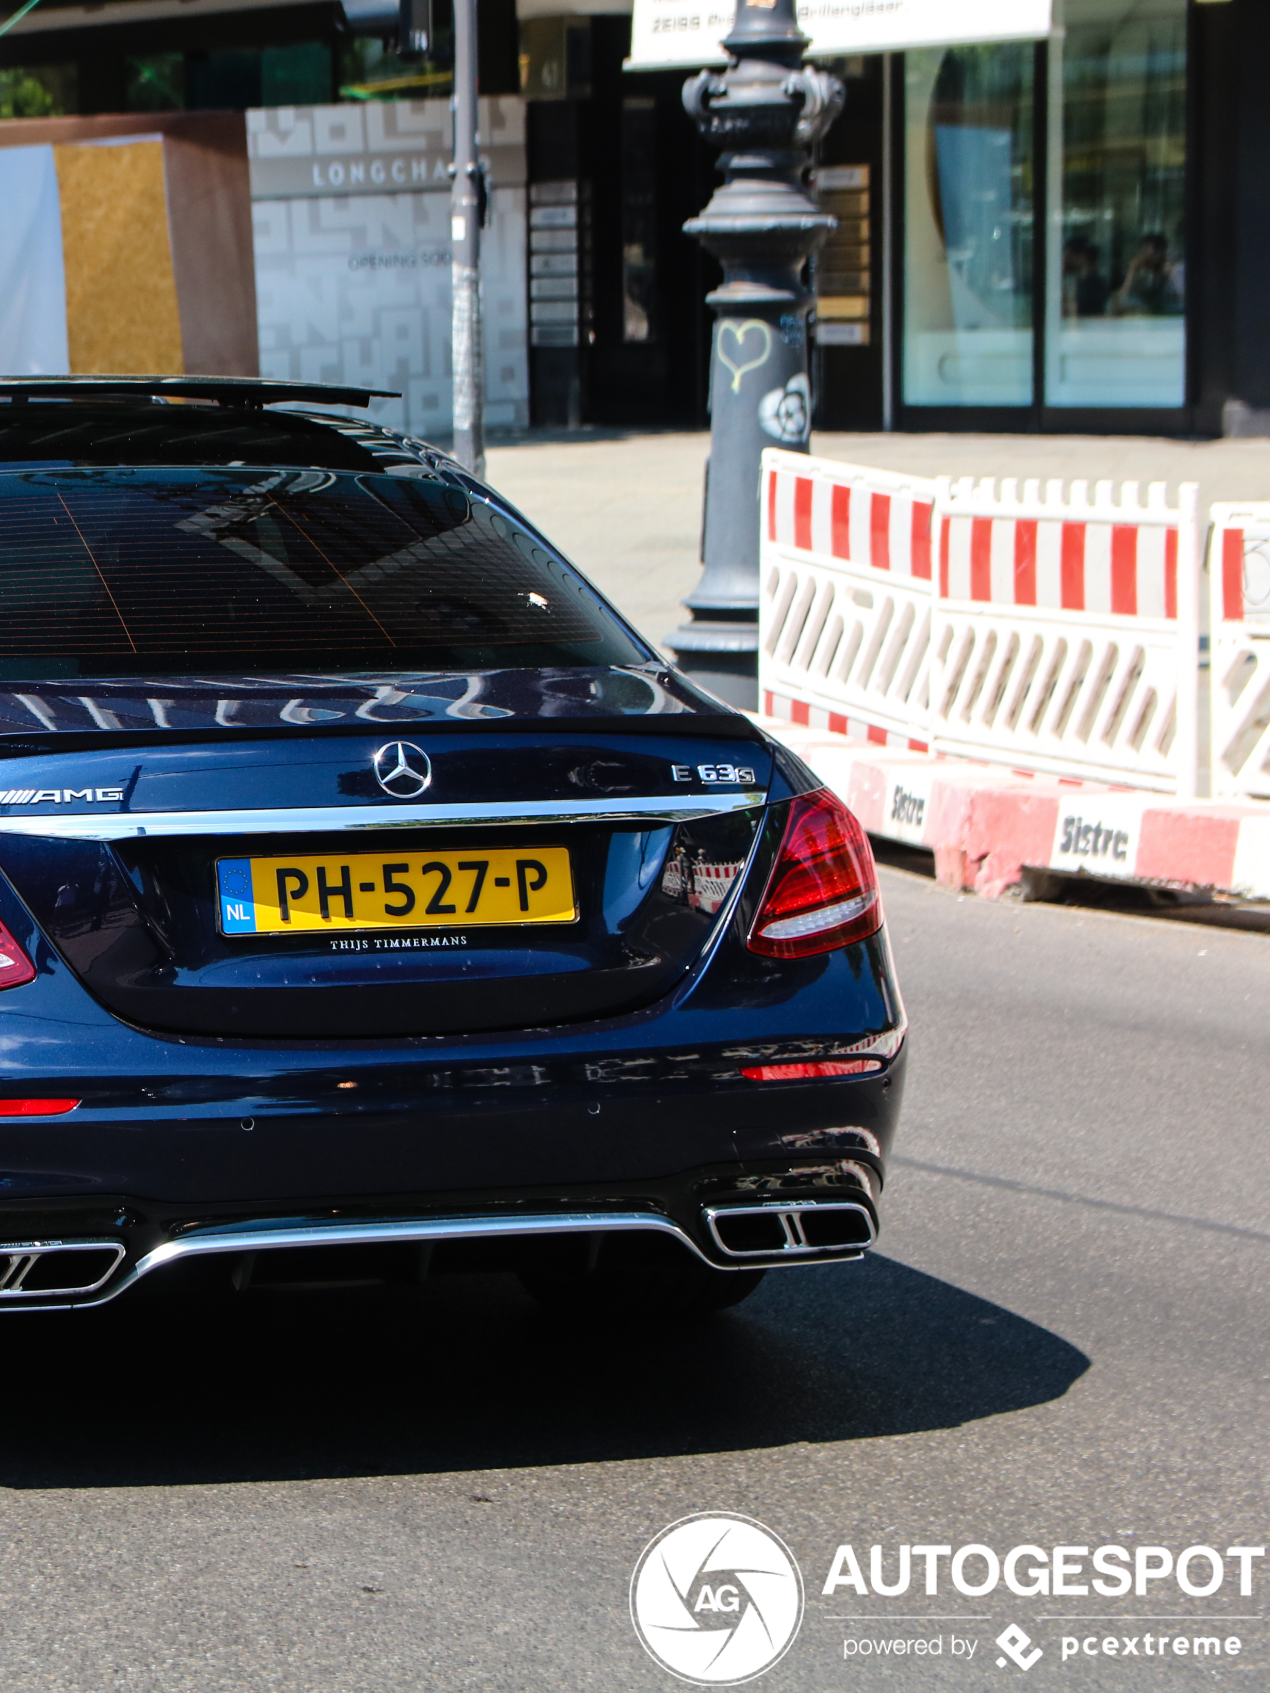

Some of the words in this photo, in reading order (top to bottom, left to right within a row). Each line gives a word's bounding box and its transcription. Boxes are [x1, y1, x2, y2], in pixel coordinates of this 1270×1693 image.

[671, 764, 693, 782] E
[30, 787, 125, 804] AMG
[226, 903, 251, 922] NL
[275, 858, 549, 922] PH-527-P
[330, 939, 369, 951] THIJS
[374, 935, 468, 949] TIMMERMANS
